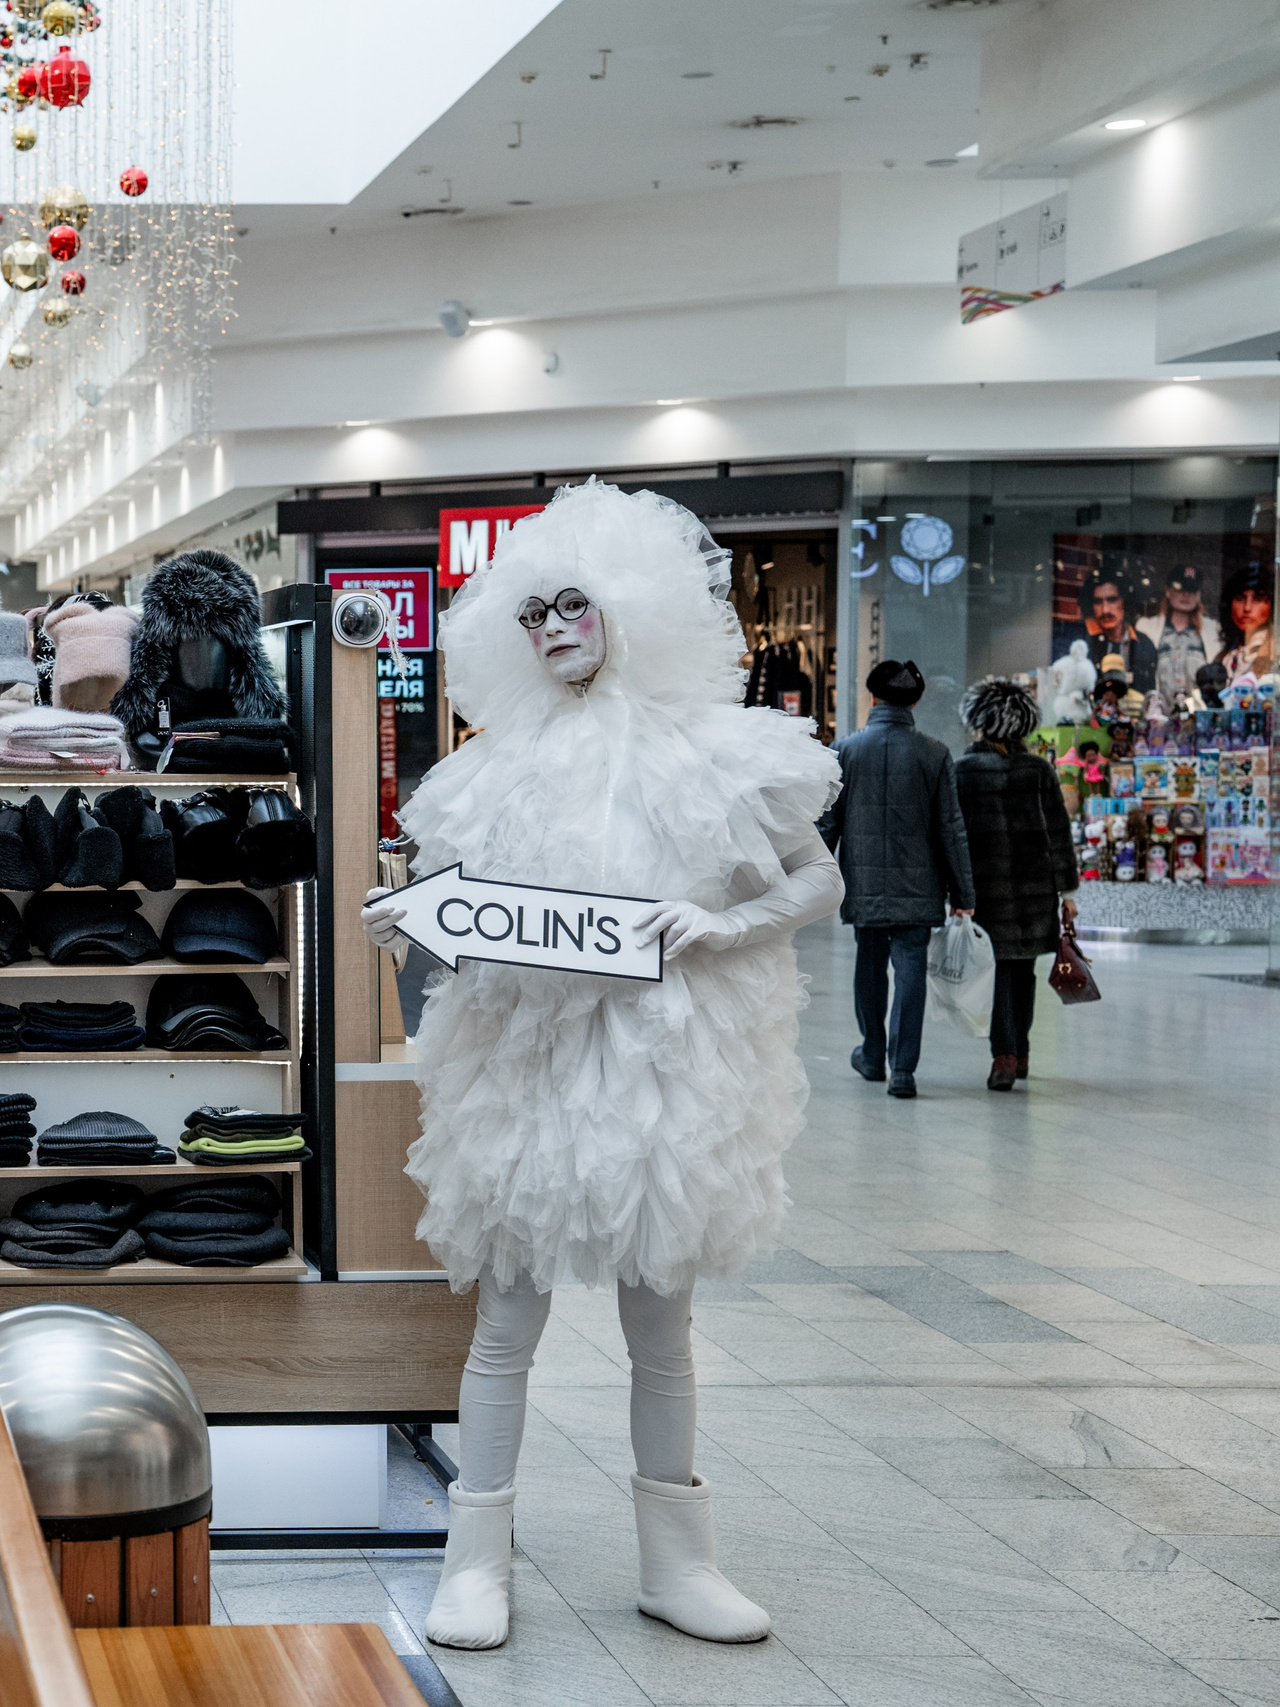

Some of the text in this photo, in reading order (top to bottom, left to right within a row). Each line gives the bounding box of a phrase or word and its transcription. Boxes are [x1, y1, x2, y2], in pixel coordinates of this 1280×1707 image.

[342, 580, 361, 589] ВСЕ
[401, 579, 415, 588] ЗА
[378, 680, 424, 698] ЕЛЯ
[437, 898, 621, 955] COLIN'S
